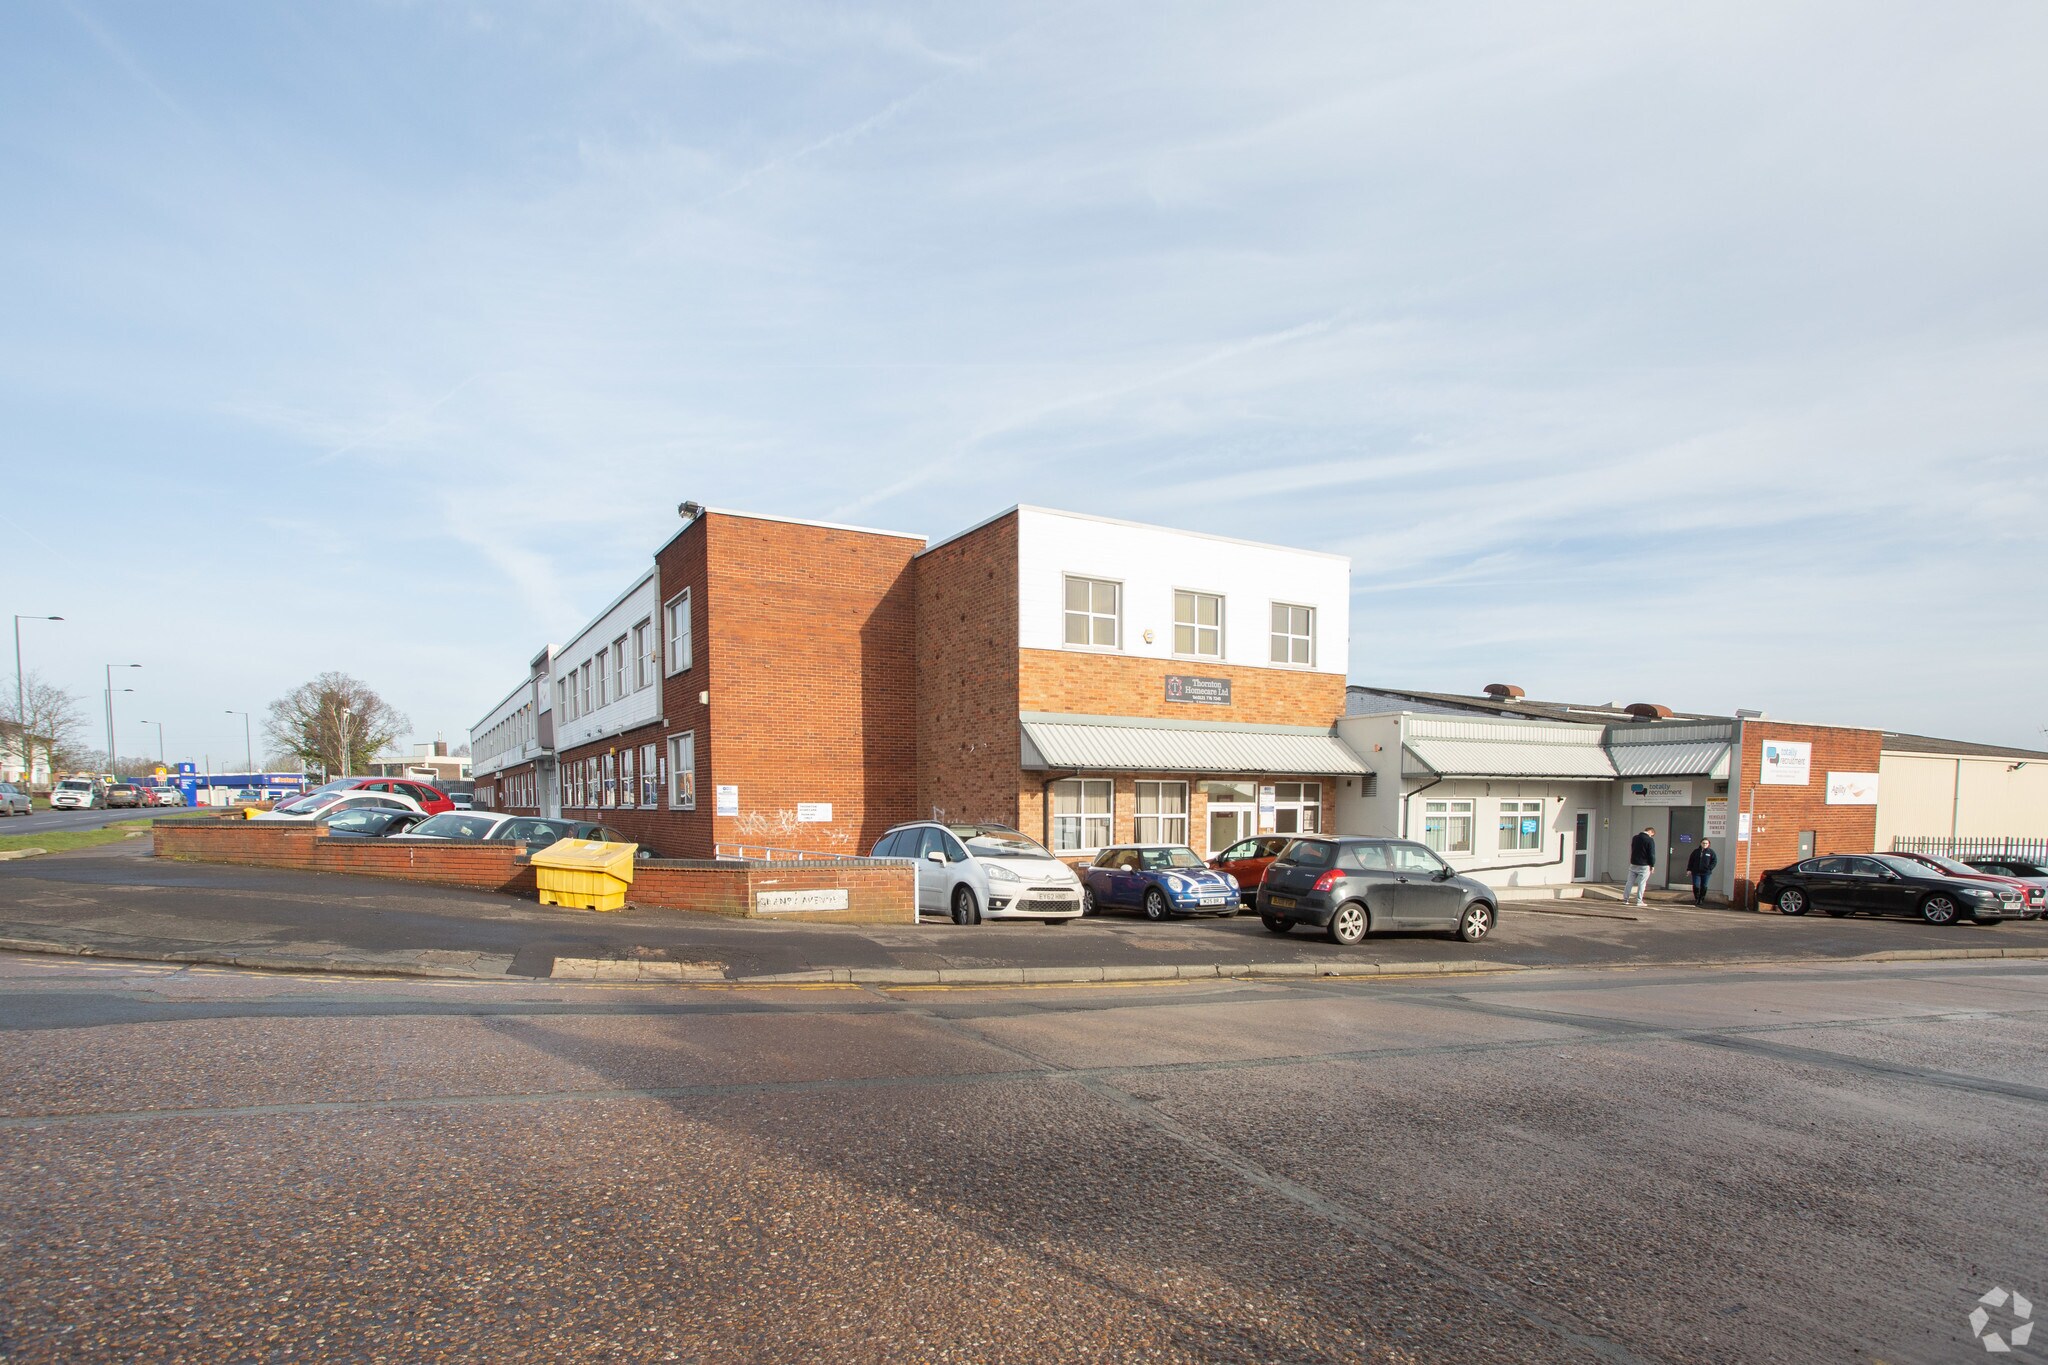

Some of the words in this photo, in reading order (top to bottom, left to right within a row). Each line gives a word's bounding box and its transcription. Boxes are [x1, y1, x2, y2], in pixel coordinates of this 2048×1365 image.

[1192, 679, 1222, 688] Thornton
[1185, 686, 1217, 695] Homecare
[1218, 688, 1229, 696] Ltd
[1780, 747, 1798, 758] totally
[1780, 757, 1806, 765] recruitment
